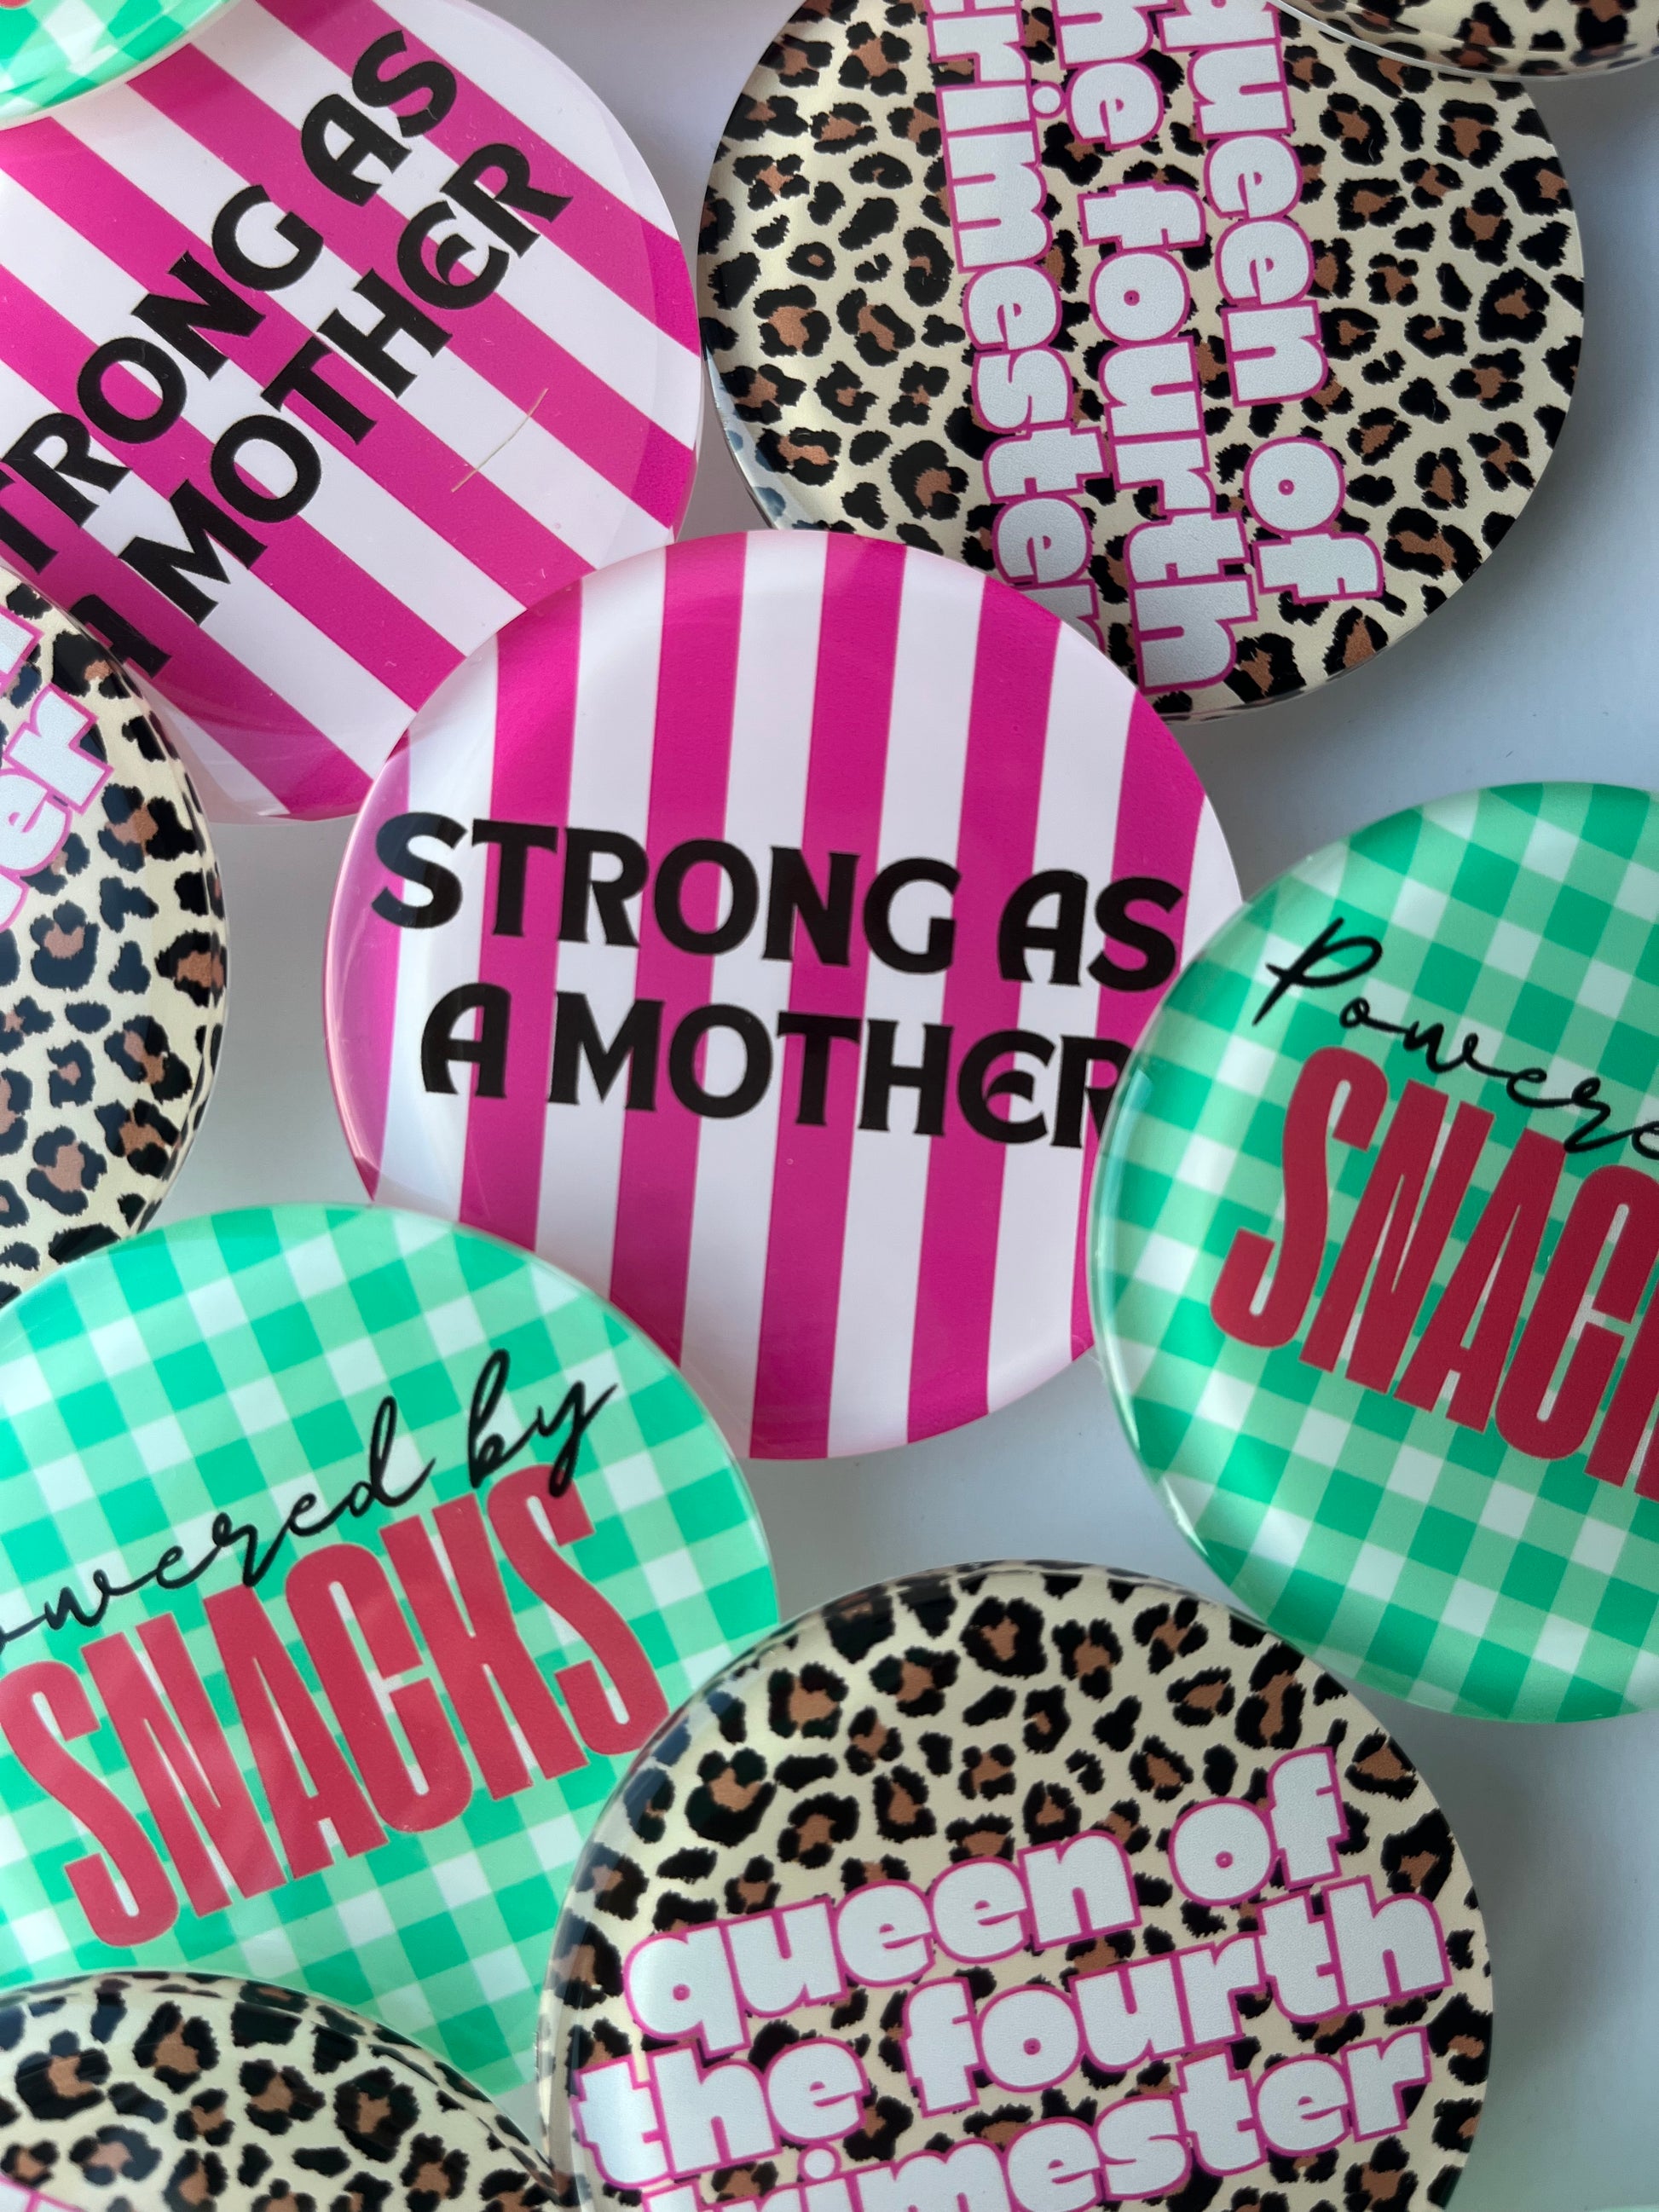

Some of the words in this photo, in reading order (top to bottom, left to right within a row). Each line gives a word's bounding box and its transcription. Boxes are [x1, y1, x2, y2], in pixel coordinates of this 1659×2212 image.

[0, 185, 323, 574] RONG
[301, 31, 456, 205] AS
[118, 143, 574, 626] MOTHER
[926, 0, 1113, 655] rimeste
[1078, 181, 1258, 696] fourth
[1242, 435, 1386, 604] of
[372, 812, 961, 973] STRONG
[997, 869, 1183, 992] AS
[420, 983, 510, 1098] A
[548, 991, 1132, 1149] MOTHER
[0, 1396, 436, 1655] wered
[468, 1349, 618, 1498] by
[0, 1464, 670, 1947] SNACKS
[570, 2036, 871, 2191] the
[902, 1874, 1454, 2118] fourth
[623, 1829, 1141, 2059] queen
[1167, 1744, 1350, 1906] of
[641, 2027, 1433, 2212] mester
